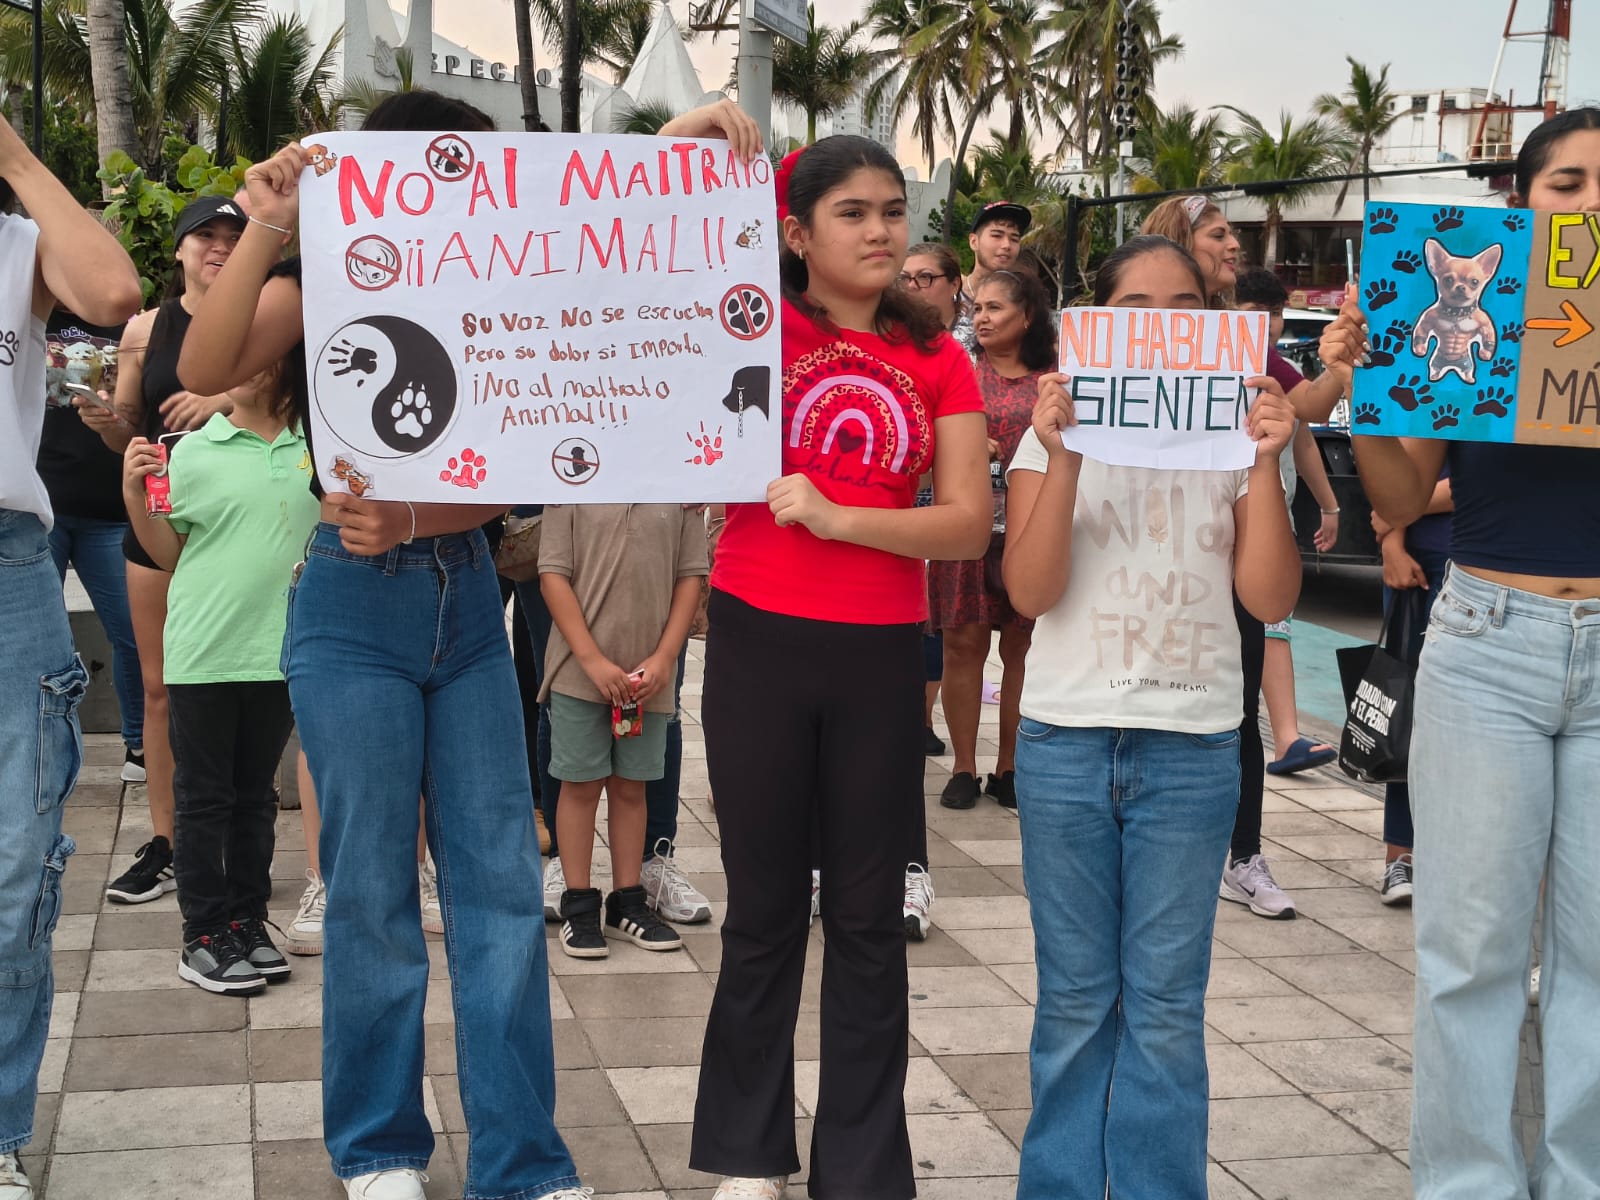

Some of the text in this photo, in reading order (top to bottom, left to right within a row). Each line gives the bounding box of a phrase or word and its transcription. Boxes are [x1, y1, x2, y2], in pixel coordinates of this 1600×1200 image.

[337, 155, 435, 226] NO
[548, 339, 591, 362] dolor
[1060, 311, 1266, 373] NO HABLAN
[1089, 607, 1223, 677] FREE
[1109, 678, 1208, 693] LIVE YOUR DREAMS
